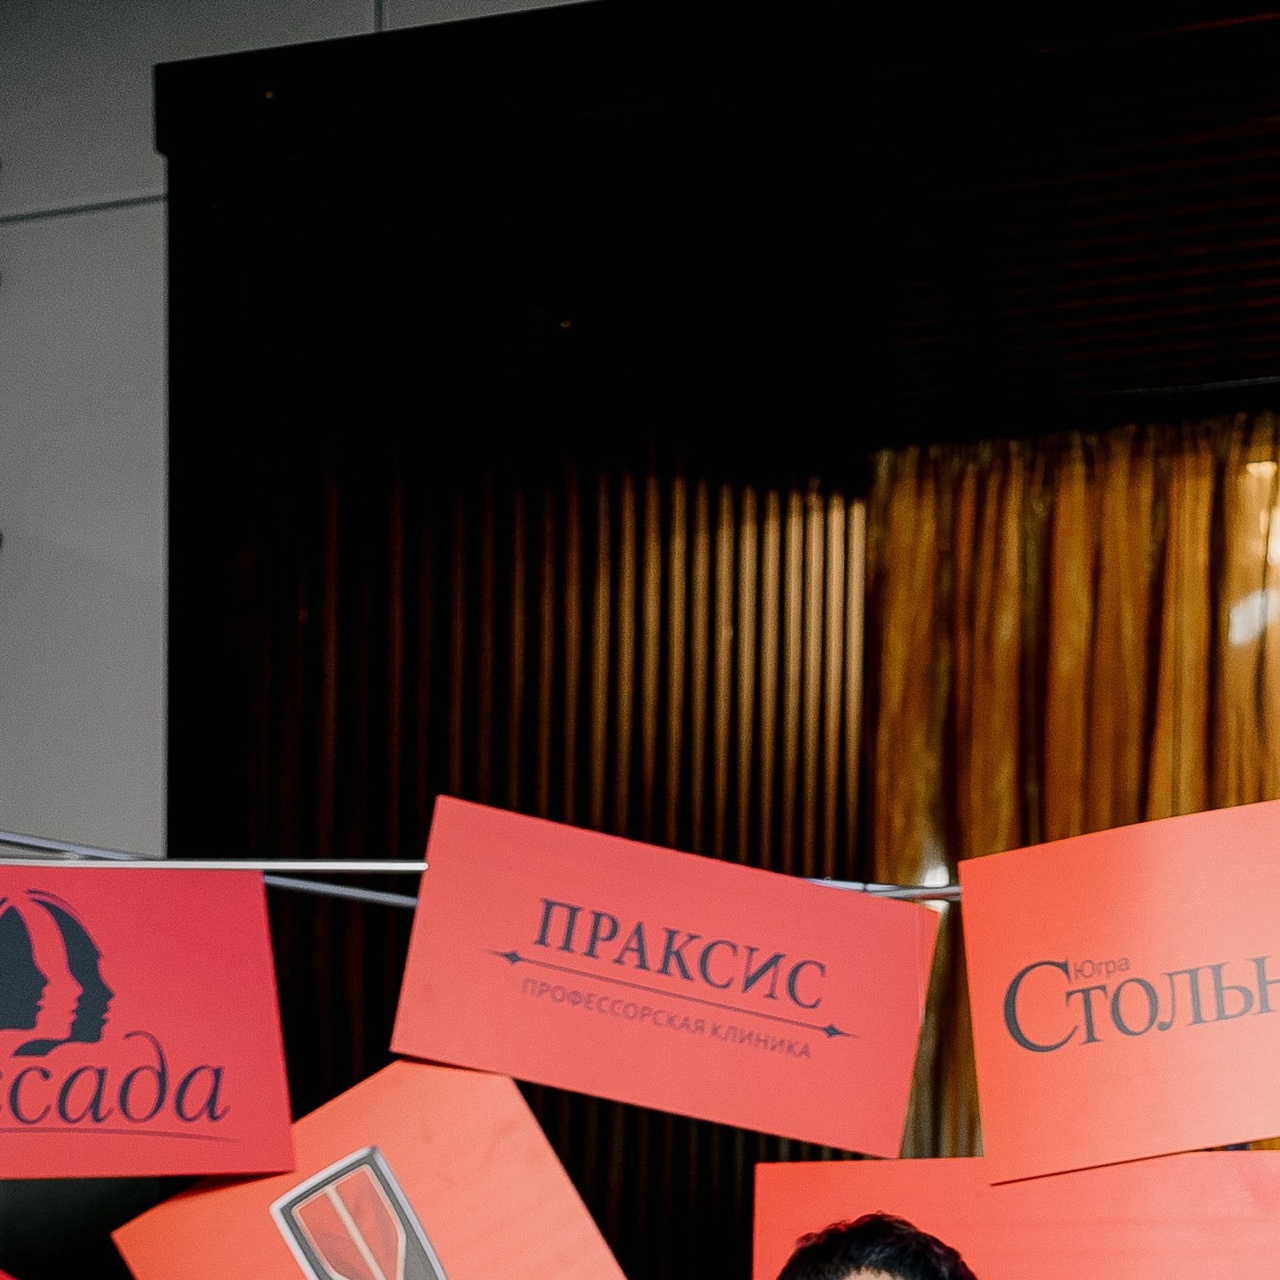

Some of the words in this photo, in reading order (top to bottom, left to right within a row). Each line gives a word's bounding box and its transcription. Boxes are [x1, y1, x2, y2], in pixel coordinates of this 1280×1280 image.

[533, 897, 827, 1010] ПРАКСИС
[1072, 954, 1130, 982] Югра
[520, 976, 706, 1034] ПРОФЕССОРСКАЯ
[708, 1023, 813, 1060] КЛИНИКА
[0, 1030, 231, 1125] сада
